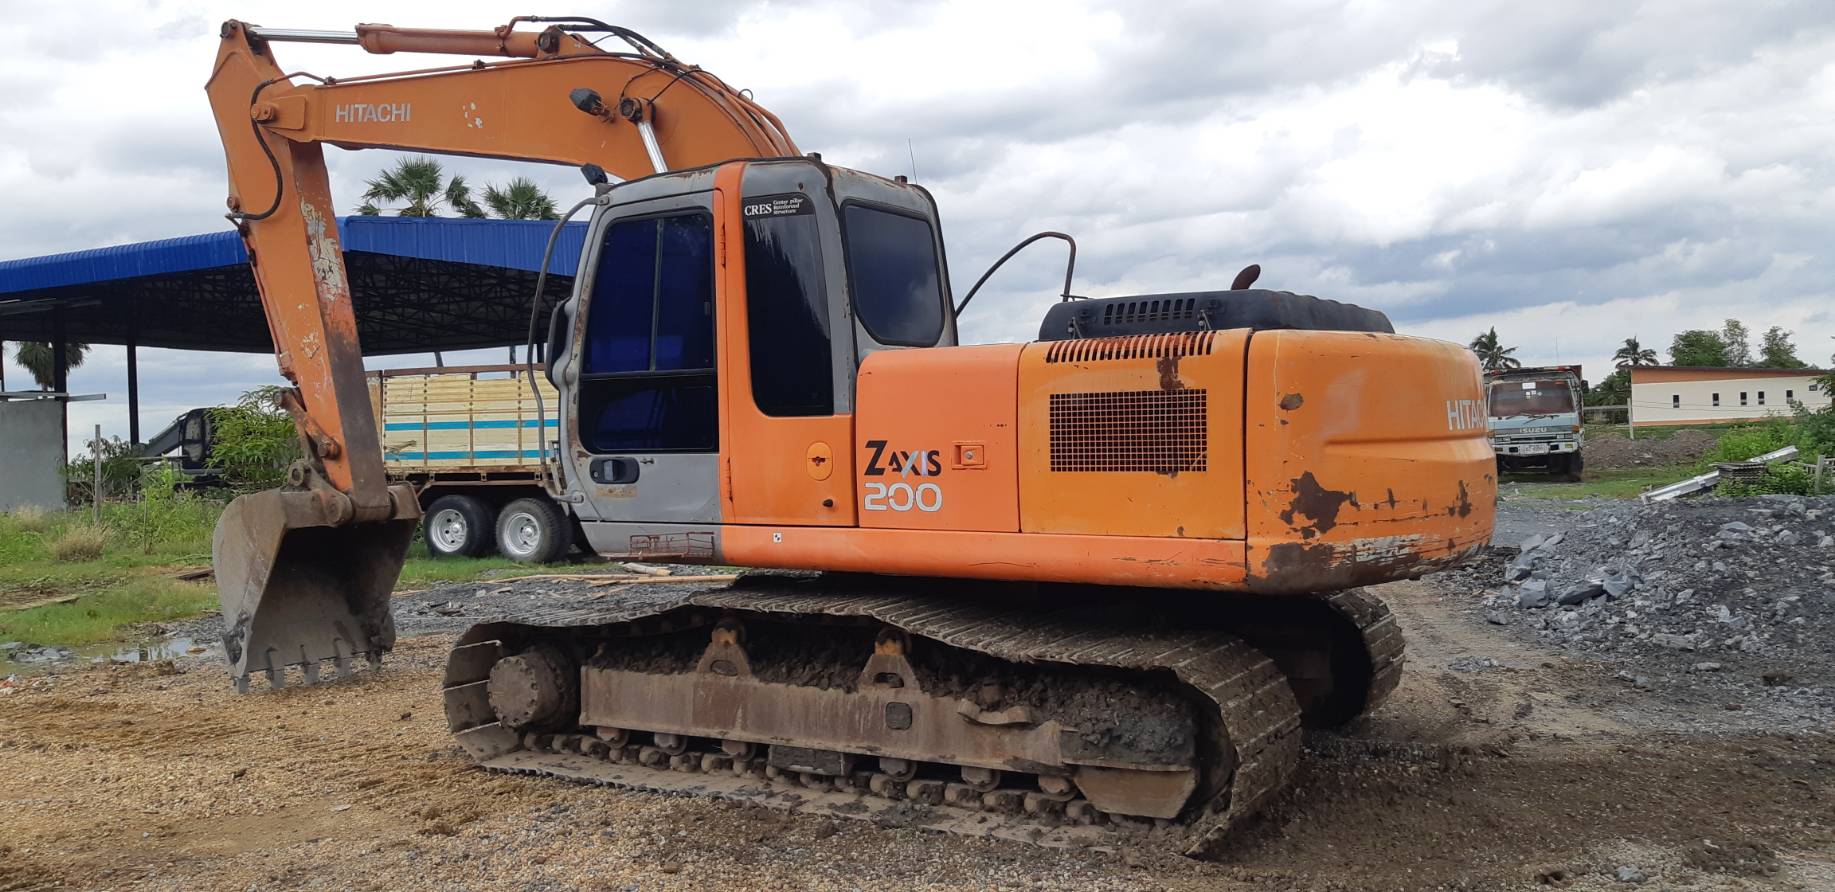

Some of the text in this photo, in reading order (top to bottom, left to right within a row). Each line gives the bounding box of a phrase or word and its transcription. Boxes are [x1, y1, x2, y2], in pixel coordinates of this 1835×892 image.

[335, 103, 411, 123] HITACHI
[744, 203, 772, 216] CRES
[1519, 426, 1548, 434] ISUZU
[864, 439, 942, 478] ZAXIS
[864, 483, 943, 512] 200
